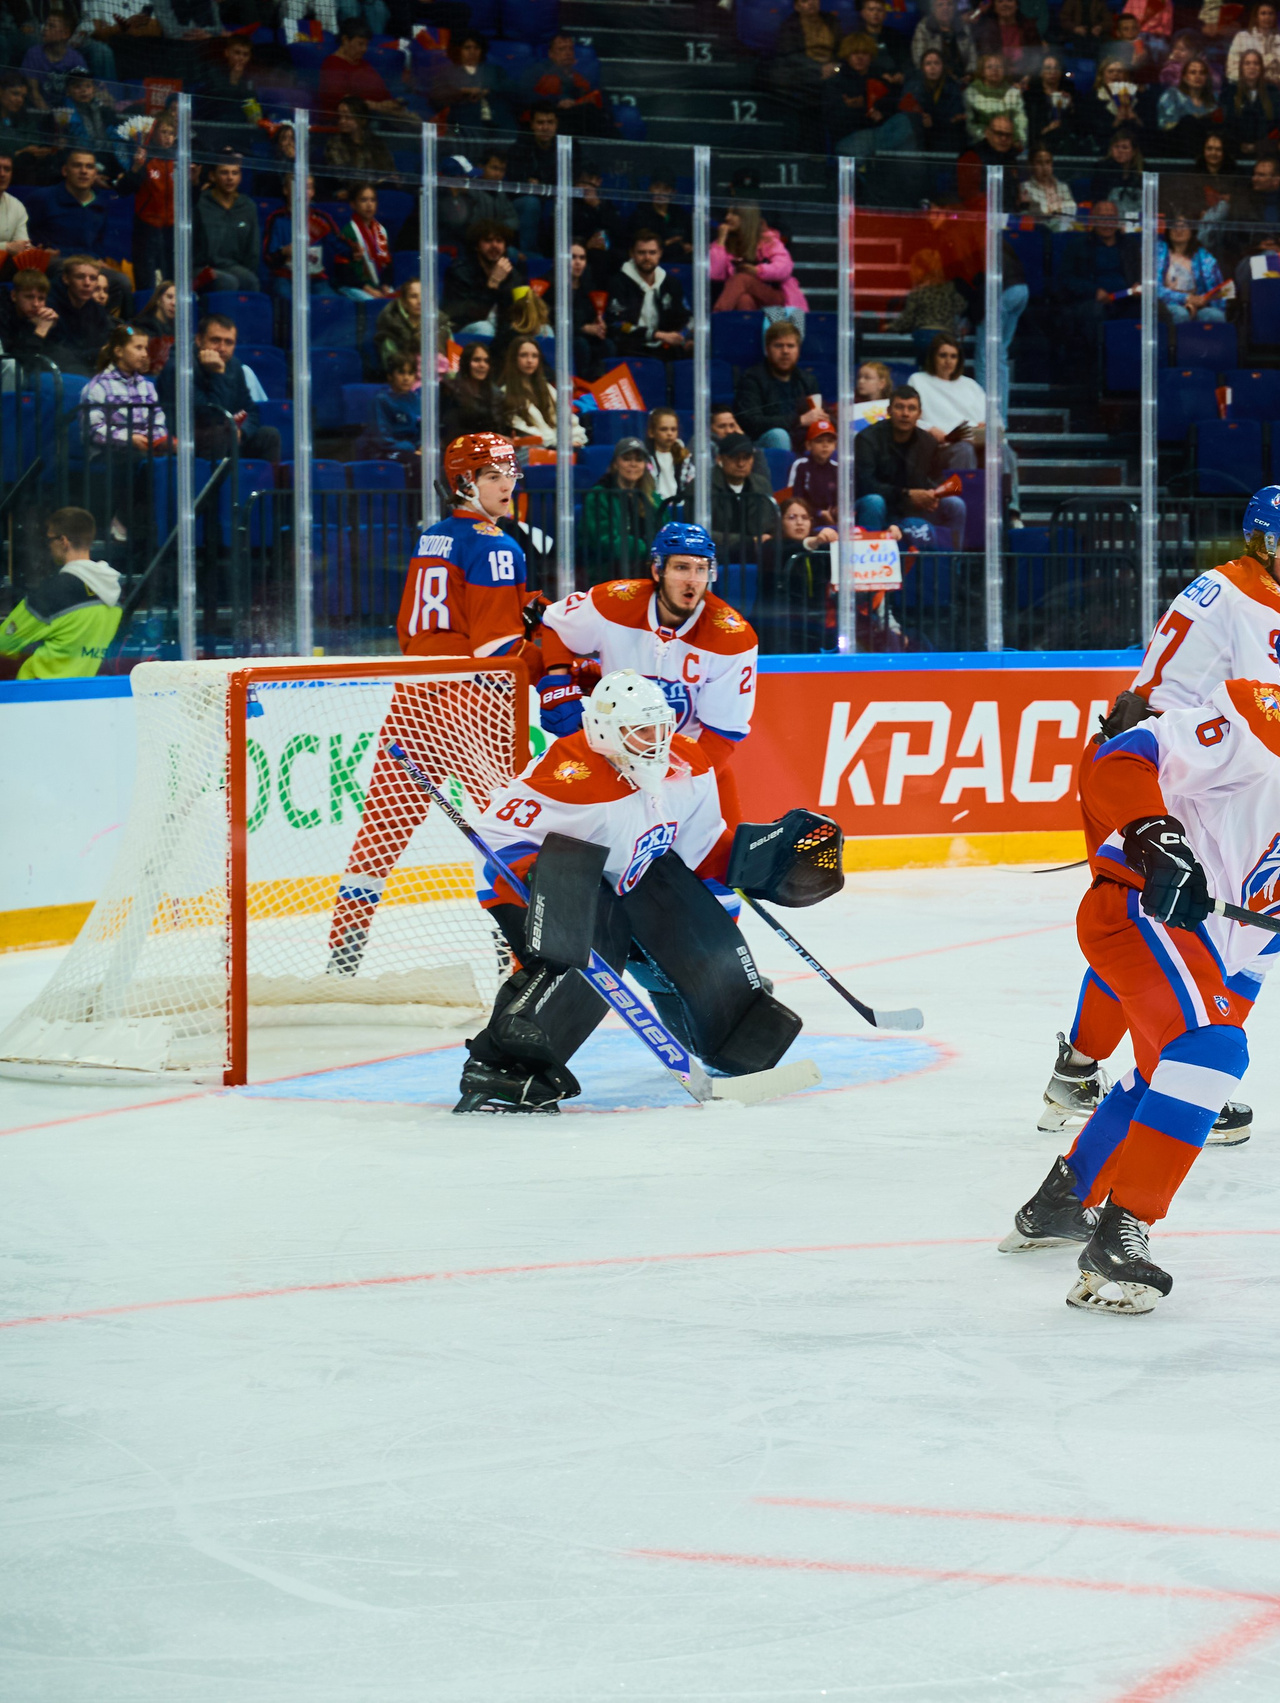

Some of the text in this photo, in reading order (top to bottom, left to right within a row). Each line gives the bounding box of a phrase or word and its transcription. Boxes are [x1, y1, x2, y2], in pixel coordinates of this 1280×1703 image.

[685, 42, 713, 64] 13
[731, 100, 759, 123] 12
[776, 163, 799, 185] 11
[1254, 518, 1270, 527] CCM
[488, 550, 515, 582] 18
[408, 566, 450, 637] 18
[682, 653, 700, 683] C
[1194, 715, 1231, 748] 6
[400, 758, 469, 828] SHADOW
[496, 798, 542, 828] 83
[750, 827, 784, 850] BAUER
[531, 893, 546, 951] BAUER
[736, 945, 761, 990] BAUER
[776, 928, 831, 981] BAUER
[591, 970, 685, 1065] BAUER
